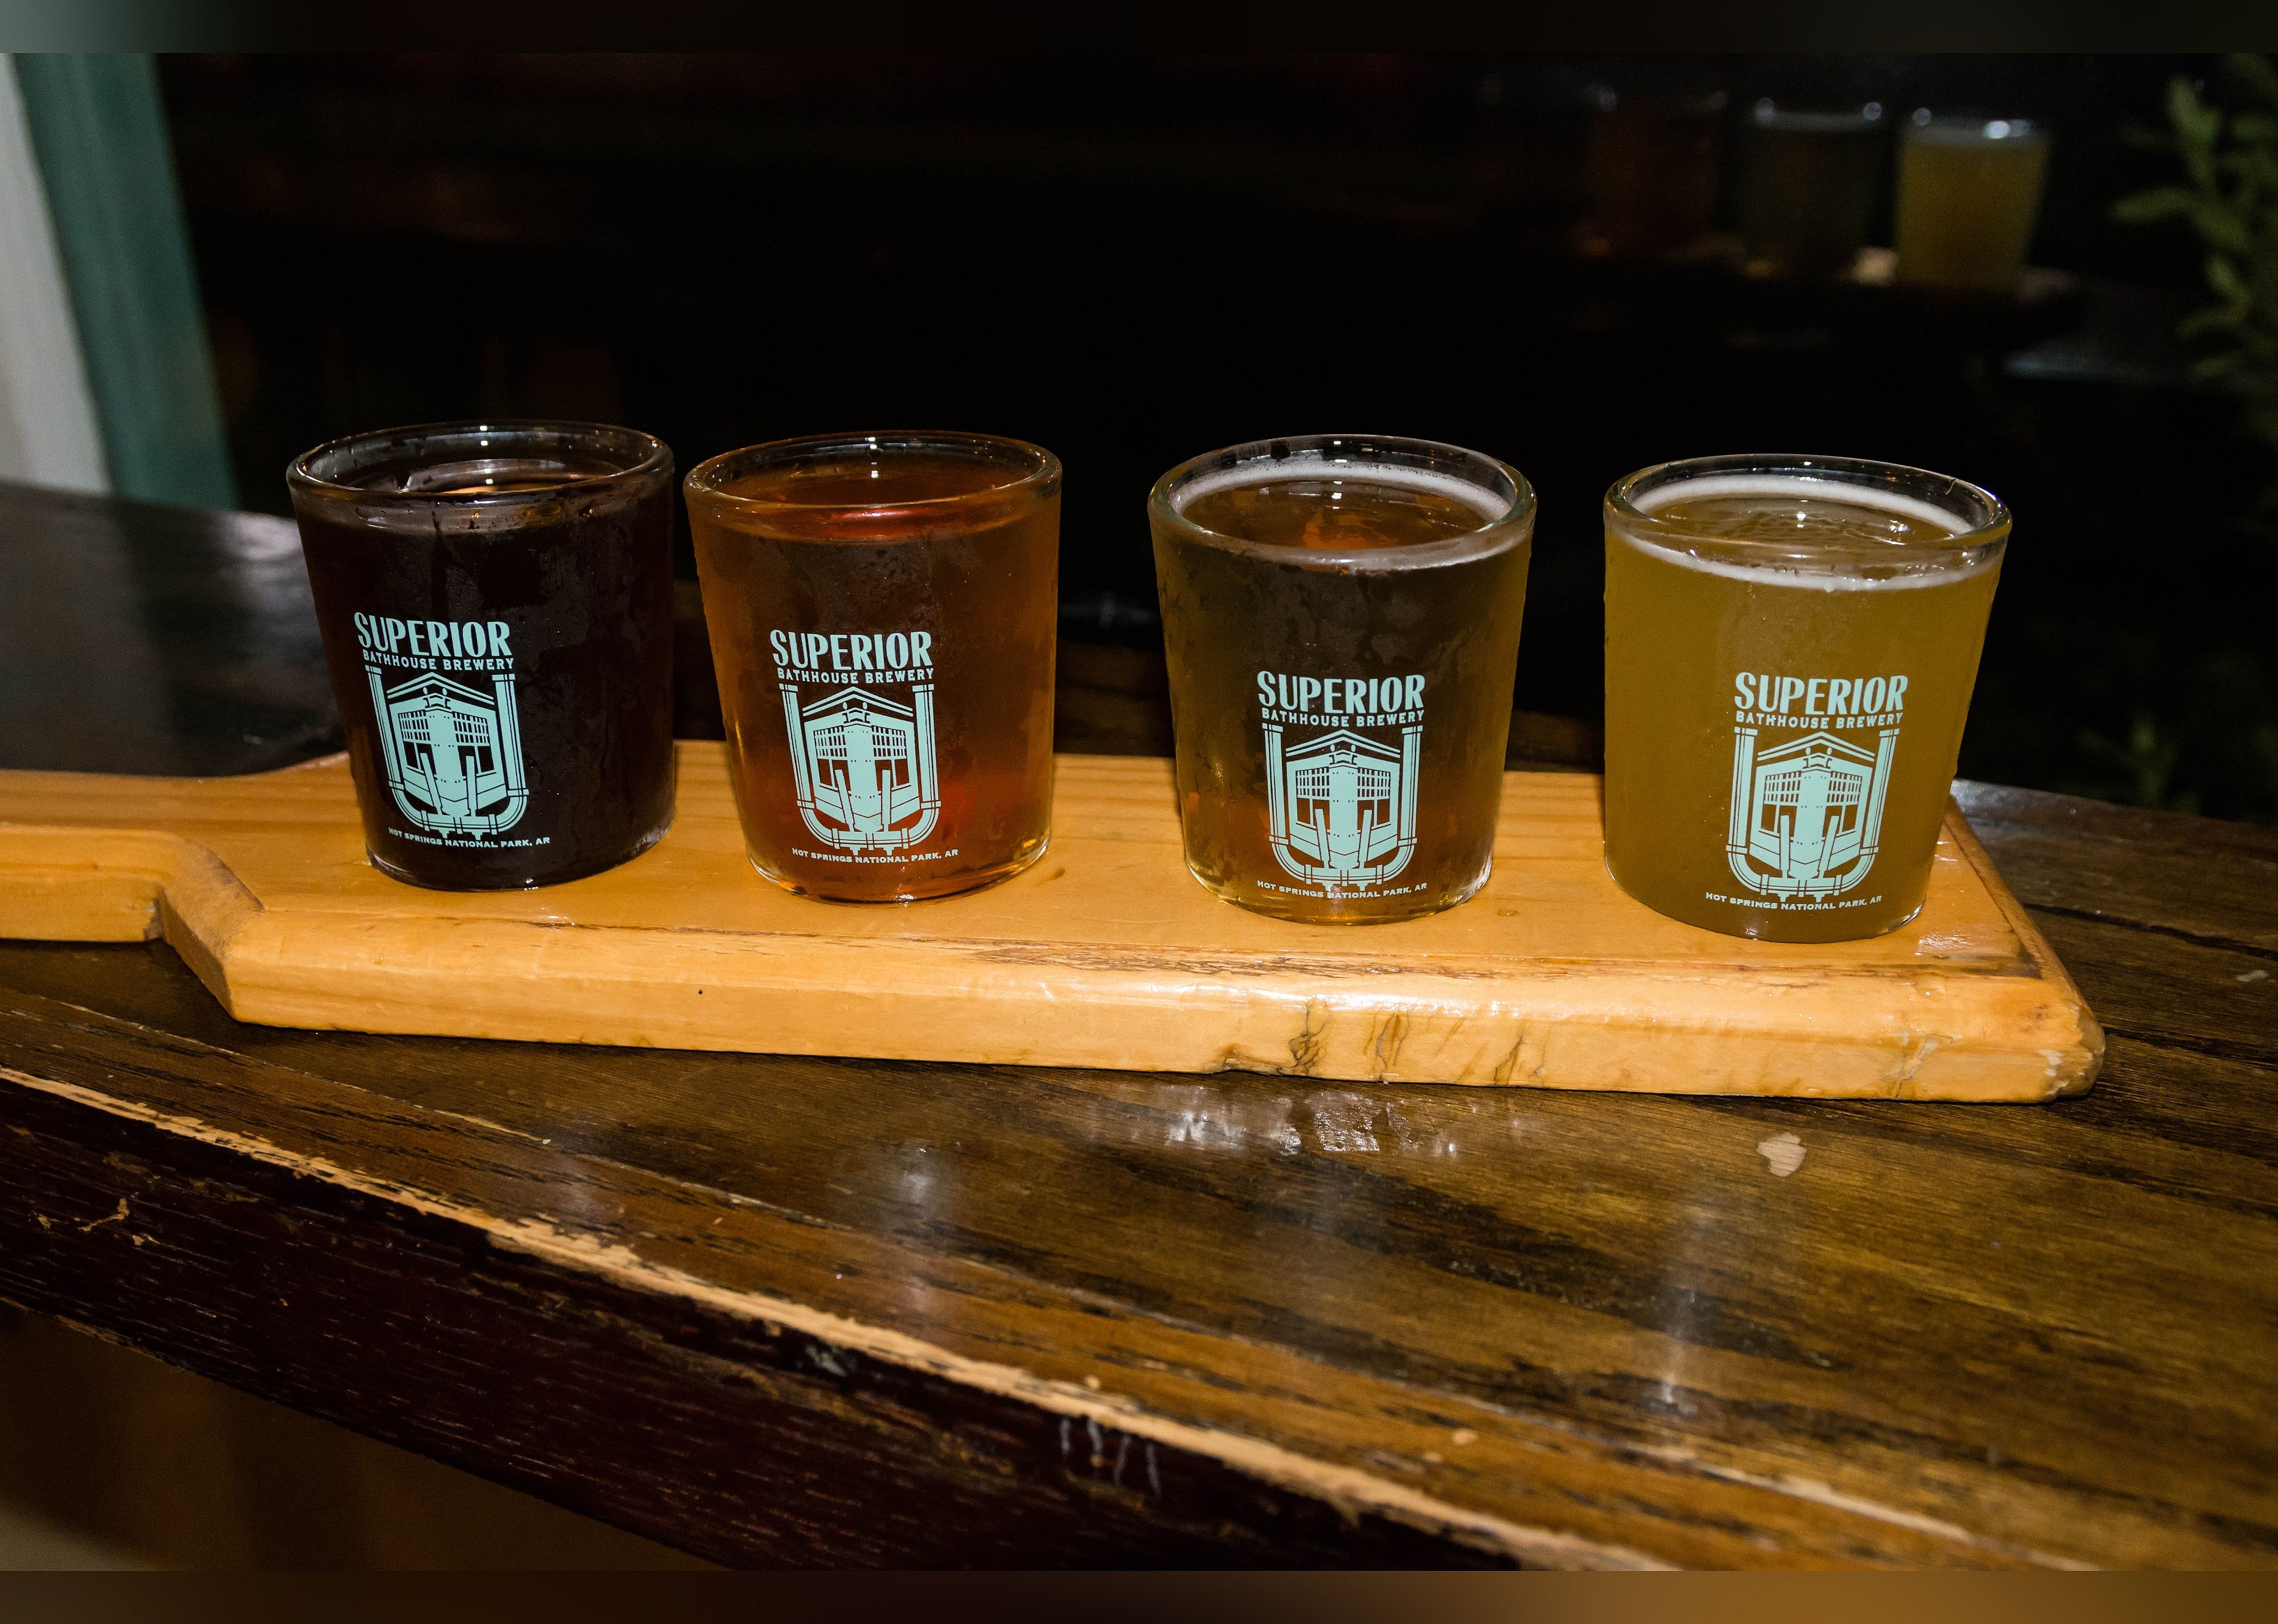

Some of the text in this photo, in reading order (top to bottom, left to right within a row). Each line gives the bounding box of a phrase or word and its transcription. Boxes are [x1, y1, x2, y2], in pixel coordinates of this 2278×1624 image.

[354, 612, 513, 658] SUPERIOR
[362, 649, 514, 671] BATHHOUSE BREWERY
[770, 629, 933, 671] SUPERIOR
[777, 667, 934, 684] BATHHOUSE BREWERY
[1257, 670, 1425, 715] SUPERIOR
[1734, 672, 1909, 715] SUPERIOR
[1261, 707, 1425, 728] BATHHOUSE BREWERY
[1735, 711, 1904, 729] BATHHOUSE BREWERY
[388, 827, 402, 837] HOT
[404, 833, 442, 845] SPRINGS
[445, 839, 498, 848] NATIONAL
[792, 848, 809, 857] HOT
[810, 852, 853, 863] SPRINGS
[944, 849, 959, 858] AR
[1257, 880, 1276, 891] HOT
[1278, 886, 1324, 898] SPRINGS
[1415, 883, 1427, 891] AR
[1705, 892, 1727, 903] HOT
[1729, 897, 1778, 909] SPRINGS
[1870, 895, 1882, 905] AR
